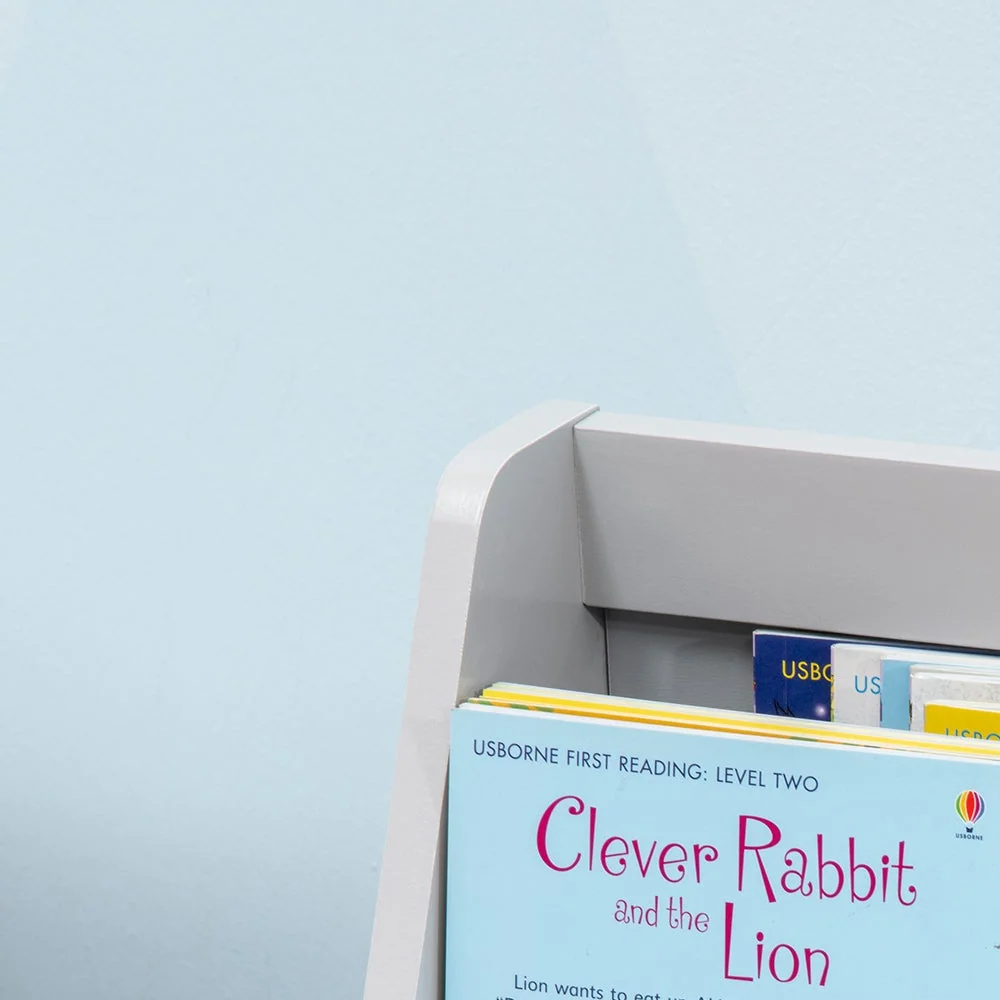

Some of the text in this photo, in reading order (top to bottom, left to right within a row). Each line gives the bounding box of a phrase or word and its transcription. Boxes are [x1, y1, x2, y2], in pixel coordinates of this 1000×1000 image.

[854, 675, 881, 695] US
[474, 739, 819, 792] USBORNE FIRST READING: LEVEL TWO
[536, 796, 719, 883] Clever
[738, 815, 917, 906] Rabbit
[955, 832, 984, 841] USBORNE
[614, 896, 831, 987] and the Lion
[515, 975, 547, 992] Lion
[555, 984, 603, 999] wants
